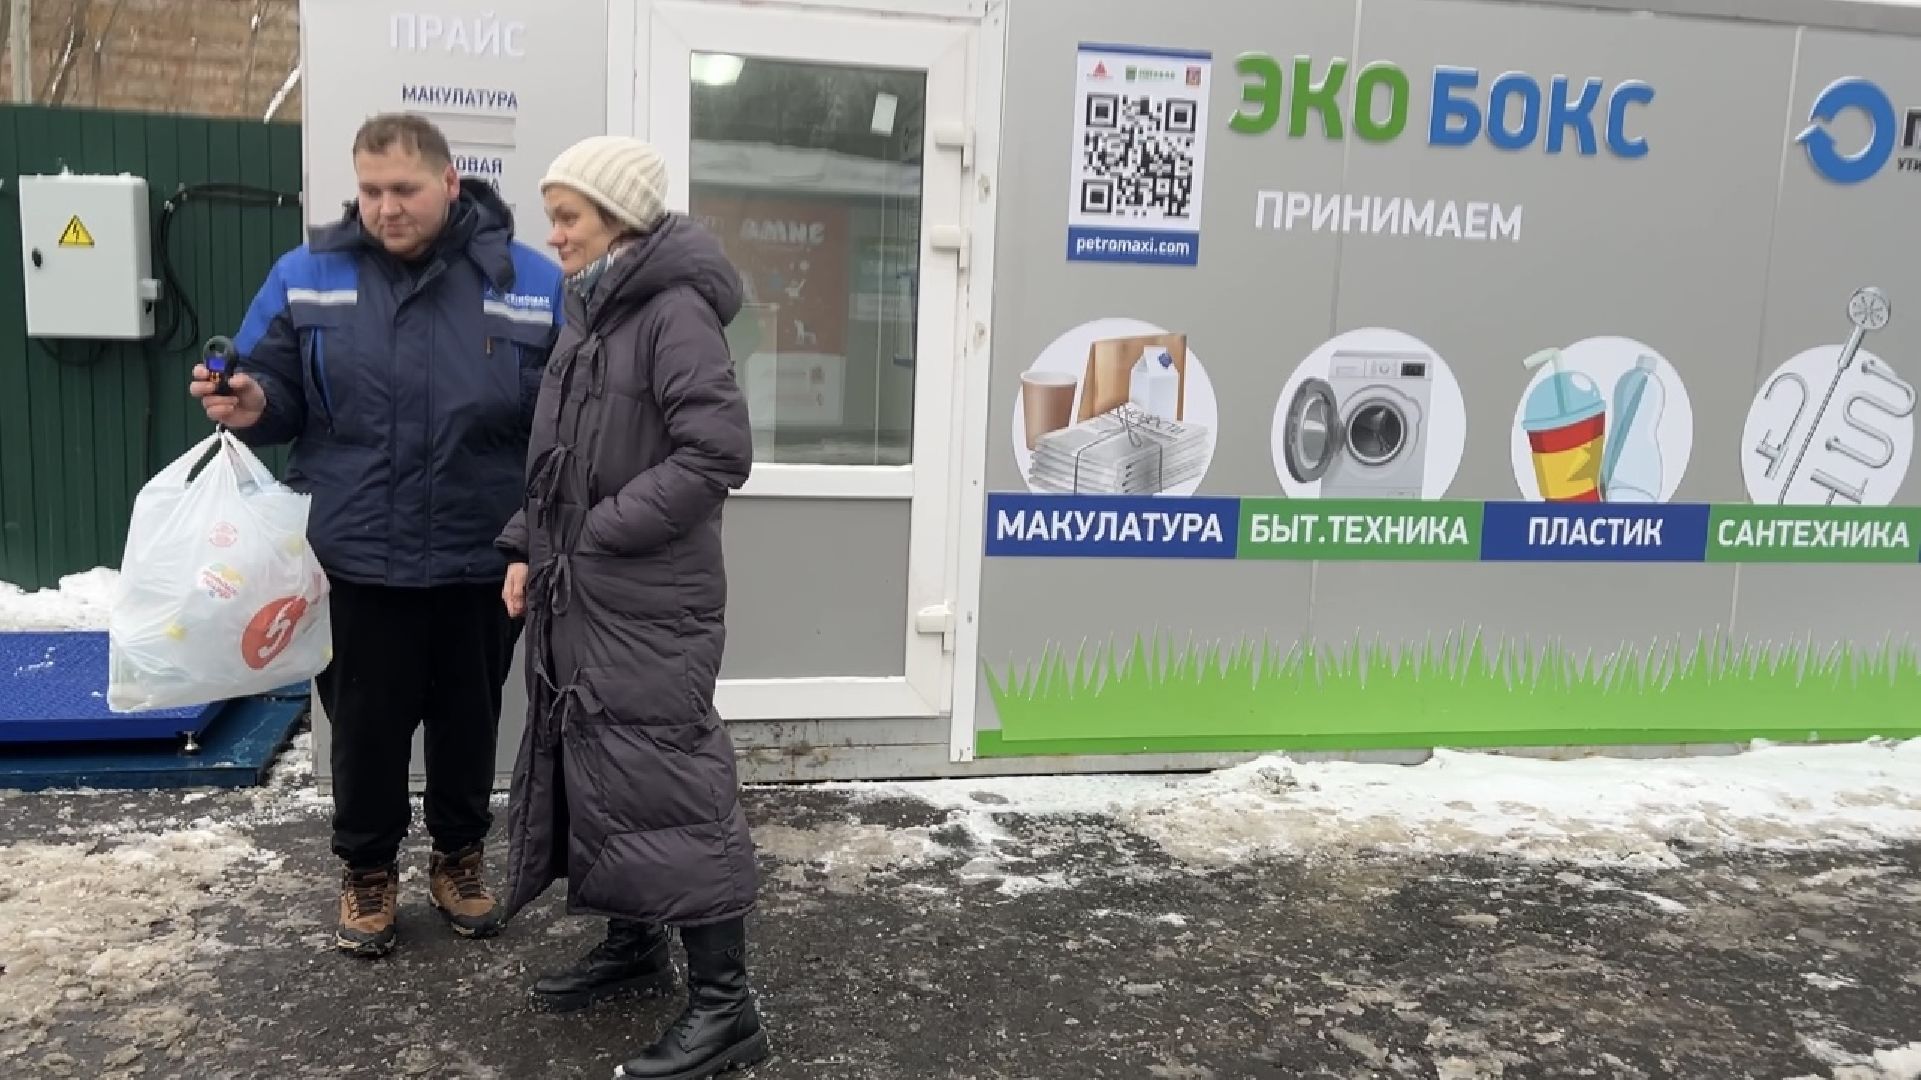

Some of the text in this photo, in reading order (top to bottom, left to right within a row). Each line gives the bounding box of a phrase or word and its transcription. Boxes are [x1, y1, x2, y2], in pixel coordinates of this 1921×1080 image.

[389, 11, 527, 57] ПРАЙС
[402, 84, 518, 109] МАКУЛАТУРА
[1228, 51, 1656, 158] ЭКО БОКС
[1255, 190, 1523, 242] ПРИНИМАЕМ
[1076, 236, 1190, 256] petromaxi.com
[996, 509, 1224, 543] МАКУЛАТУРА
[1250, 513, 1469, 545] БЫТ.ТЕХНИКА
[1528, 516, 1664, 546] ПЛАСТИК
[1717, 519, 1910, 549] САНТЕХНИКА
